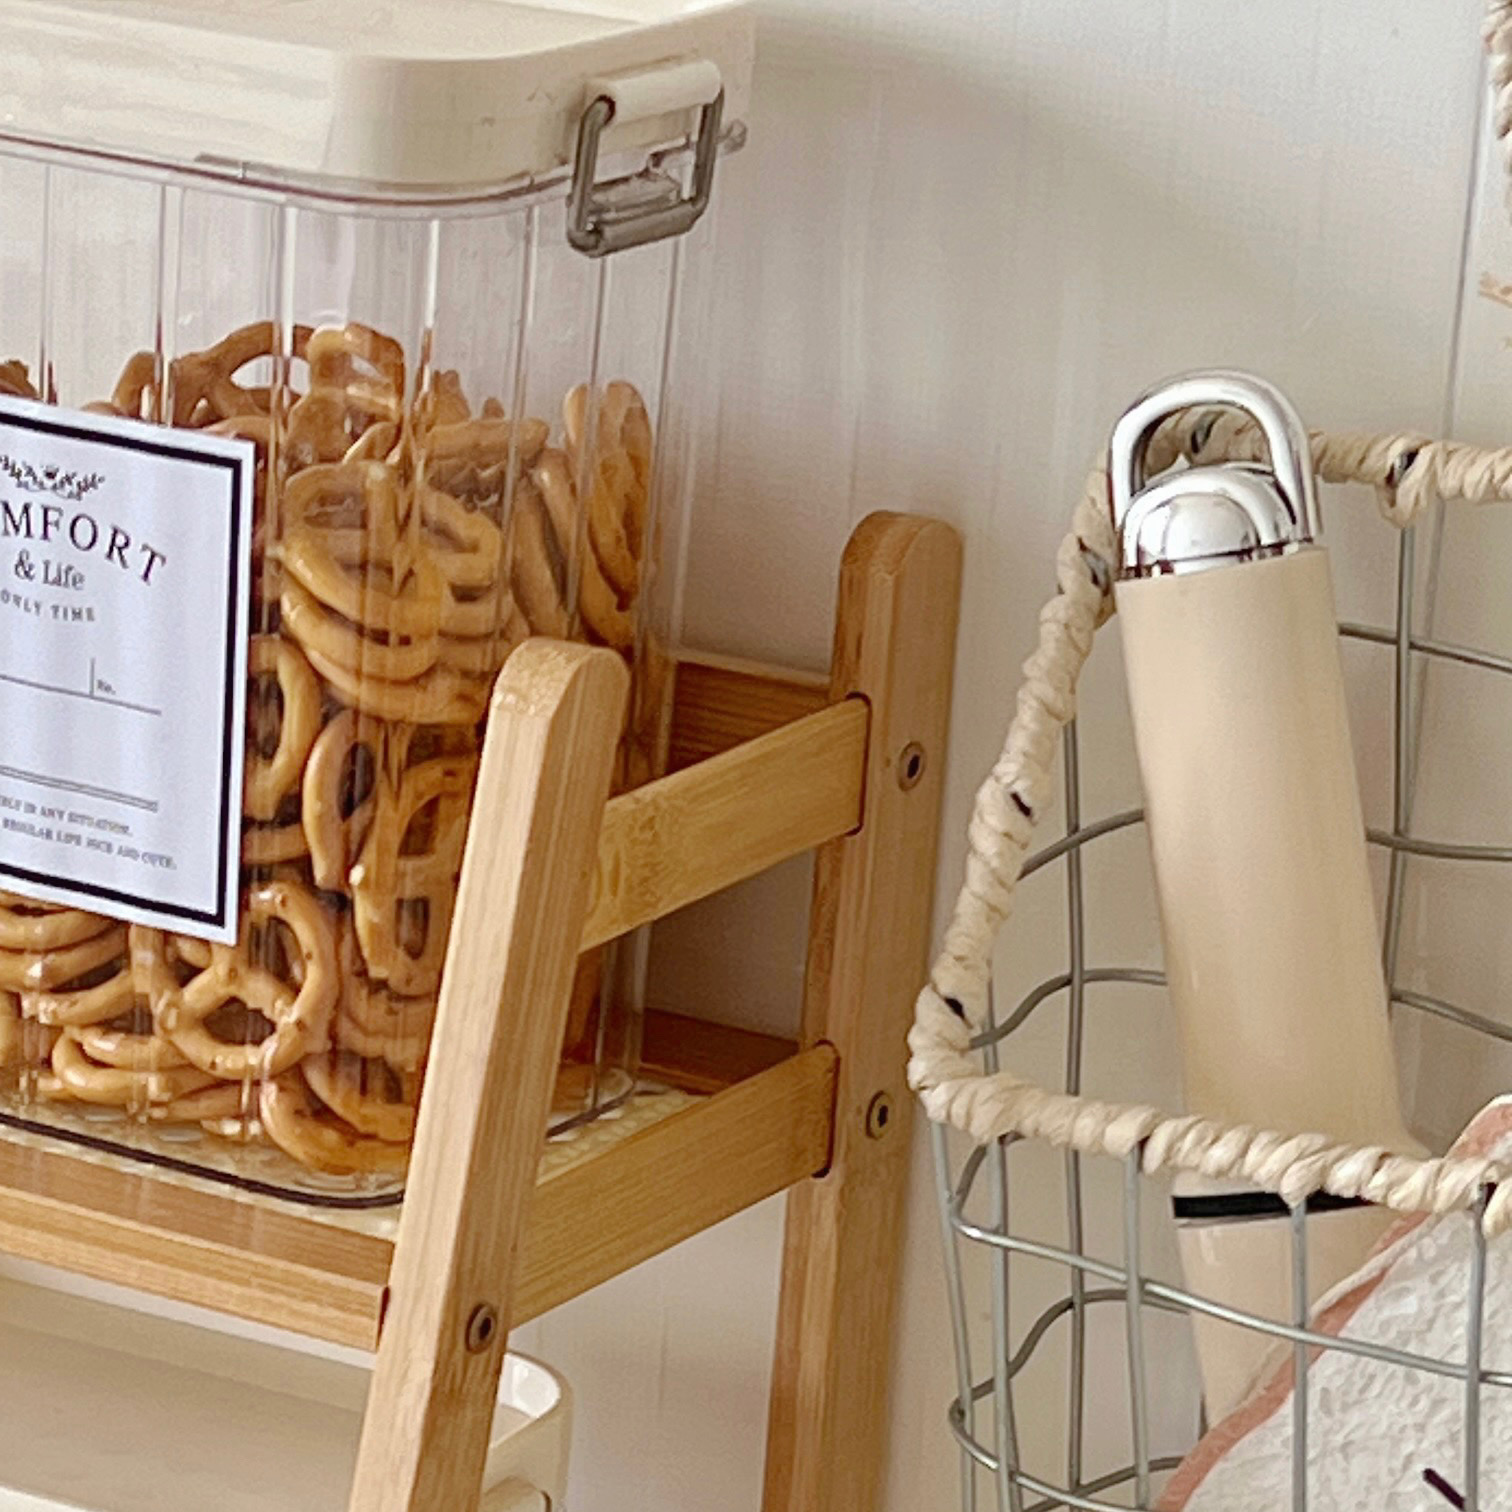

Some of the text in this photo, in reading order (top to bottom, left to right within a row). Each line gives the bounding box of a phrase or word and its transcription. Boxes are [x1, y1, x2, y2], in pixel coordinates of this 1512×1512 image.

[14, 549, 85, 591] & Life
[0, 588, 96, 622] ONLY TIME
